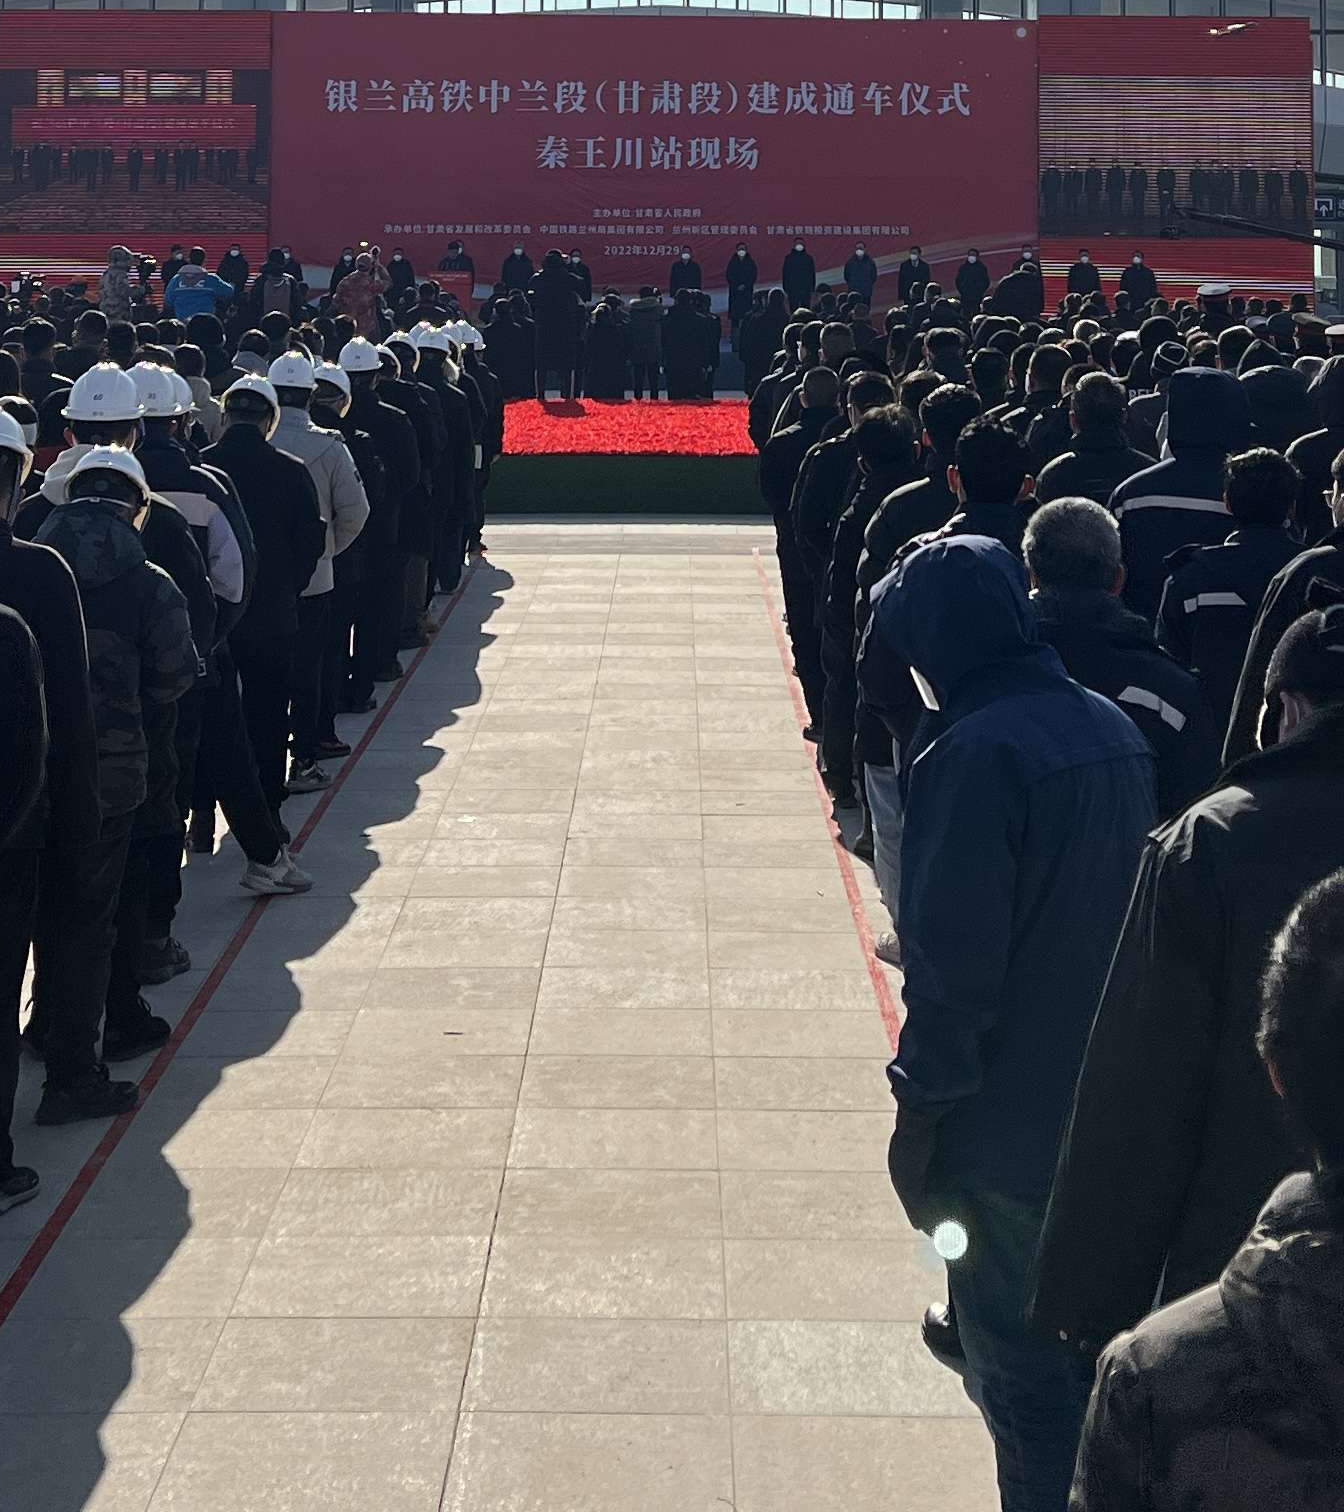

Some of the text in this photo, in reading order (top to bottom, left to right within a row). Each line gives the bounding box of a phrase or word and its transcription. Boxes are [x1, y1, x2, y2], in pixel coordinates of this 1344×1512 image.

[324, 79, 971, 116] 银兰高铁中兰段(甘肃段)建成通车仪式
[536, 136, 759, 170] 秦王川站现场
[604, 246, 682, 256] 2022年12月29
